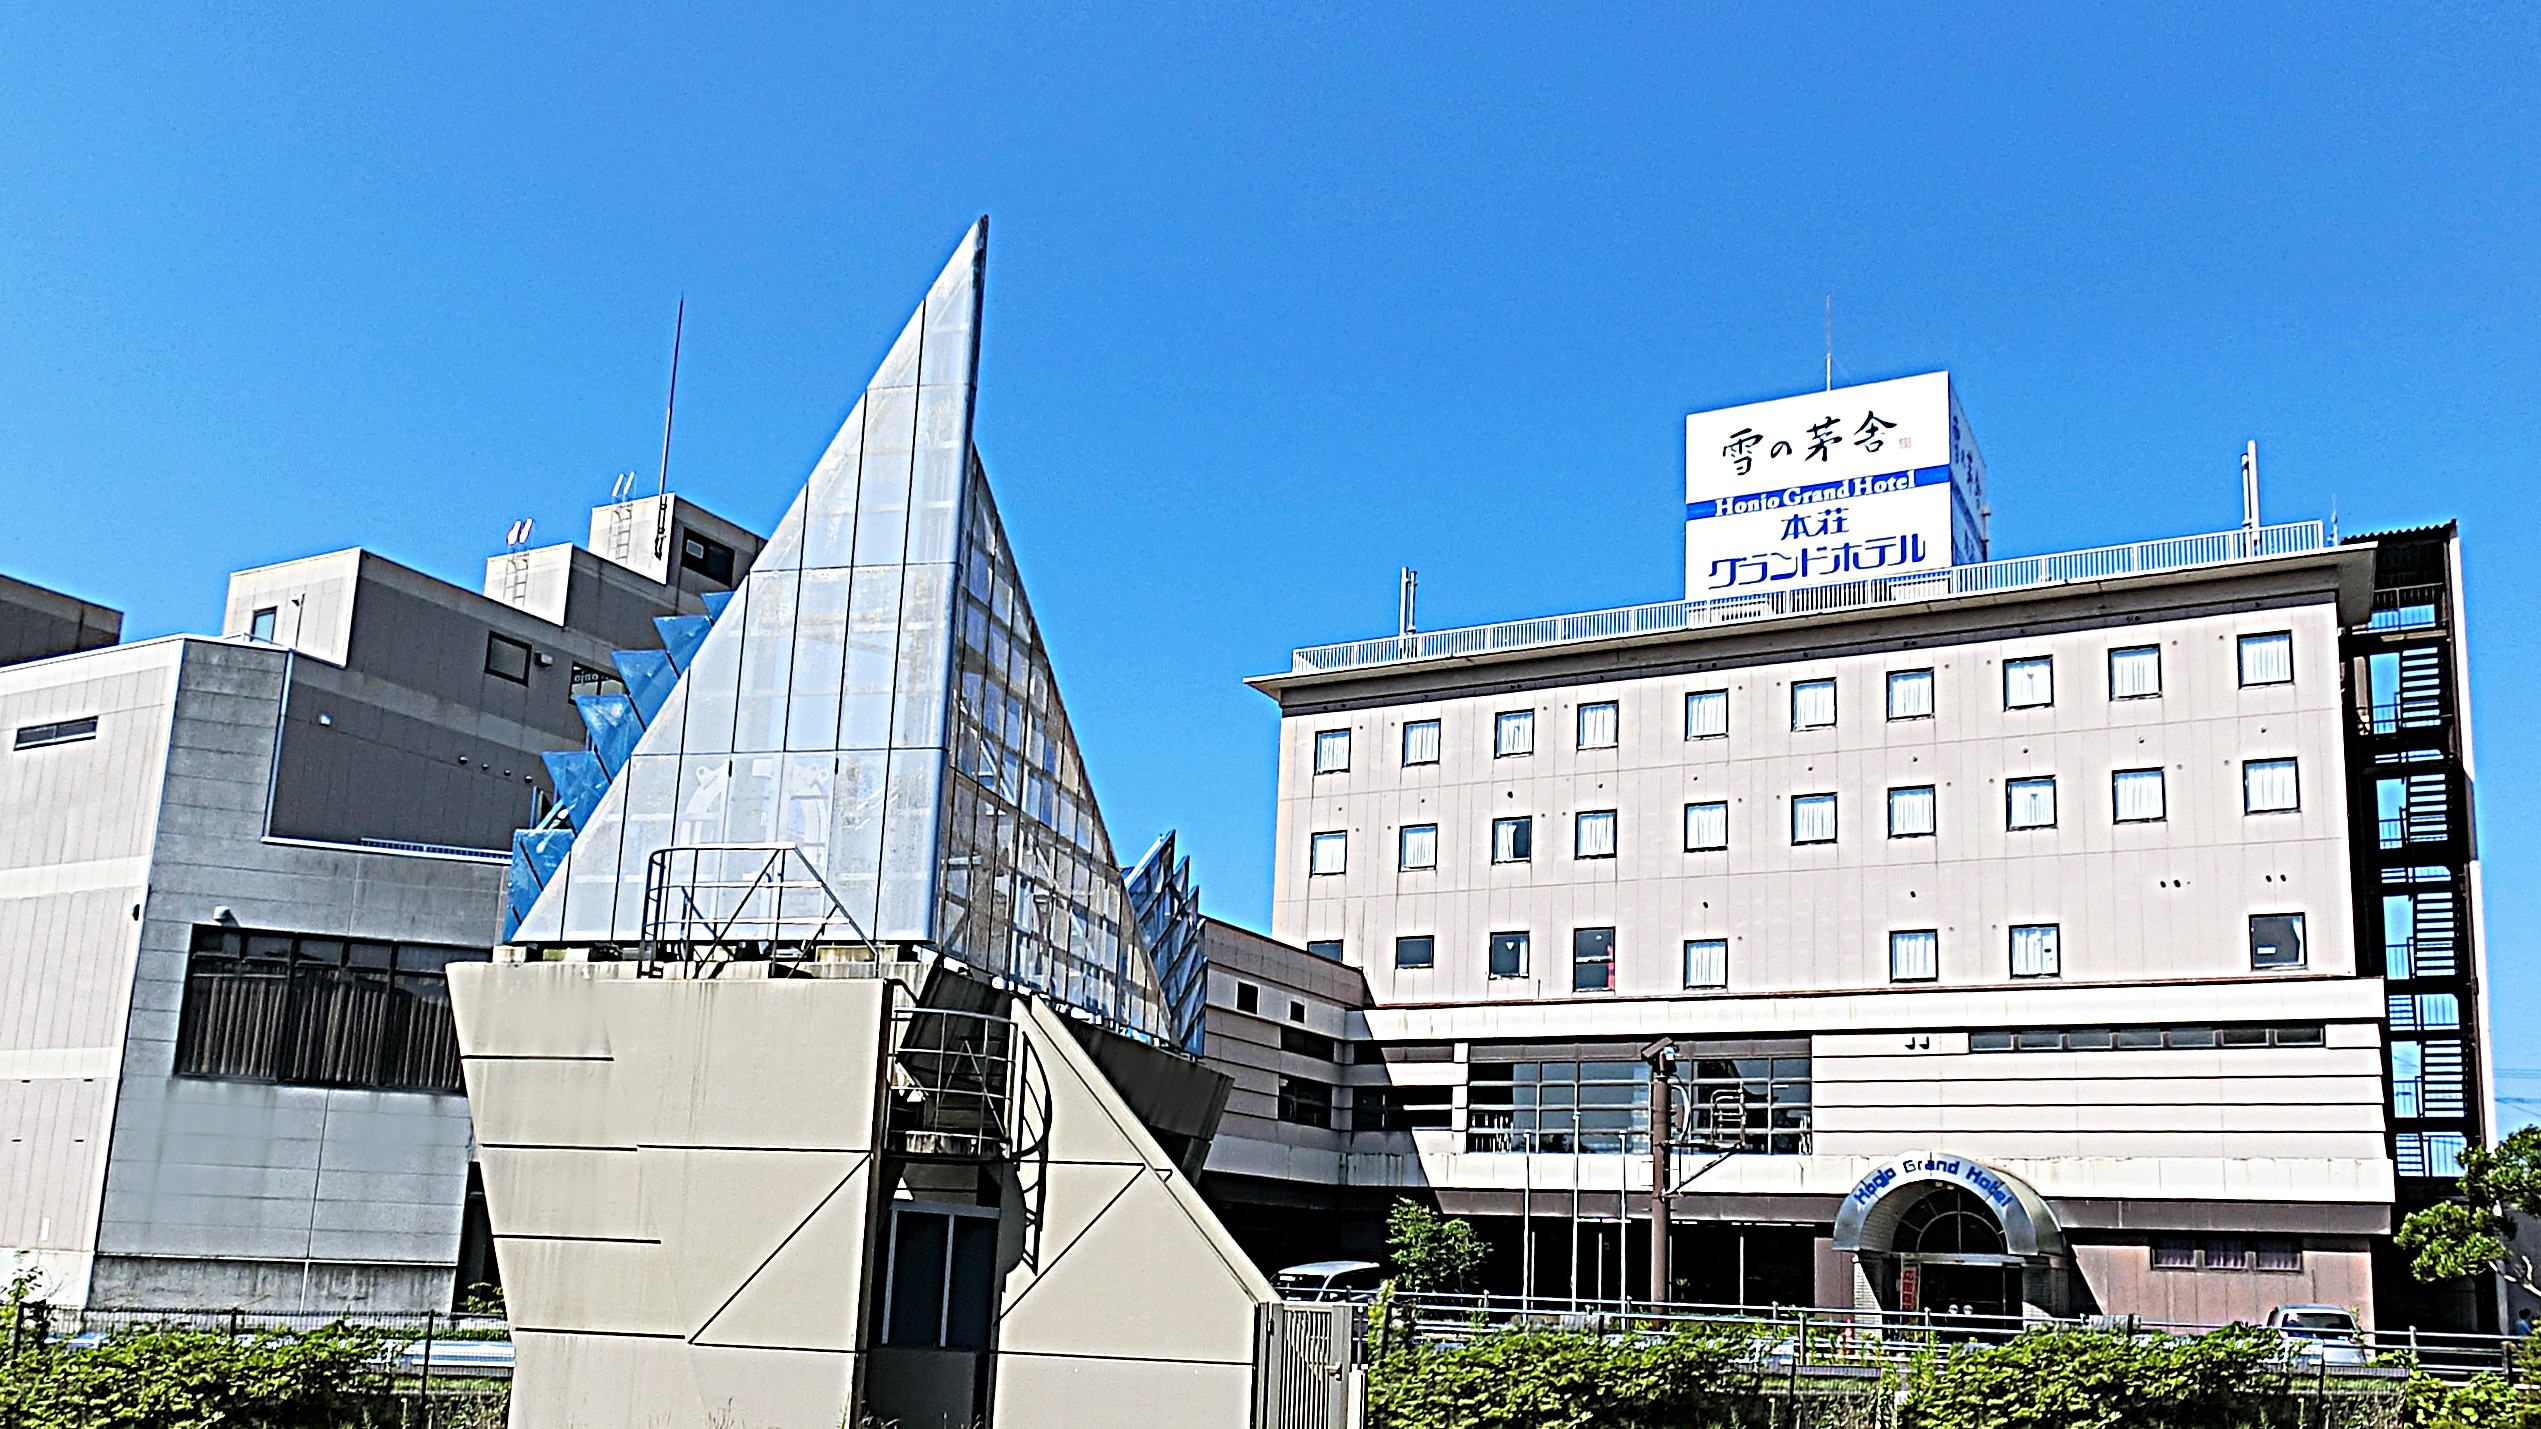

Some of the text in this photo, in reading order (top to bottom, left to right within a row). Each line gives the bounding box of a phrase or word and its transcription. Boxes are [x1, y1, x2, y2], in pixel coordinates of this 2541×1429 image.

[1714, 469, 1916, 518] Honjo Grand Hotel
[1780, 507, 1850, 541] 本荘
[1708, 533, 1926, 591] グランドホテル
[1902, 1159, 1961, 1176] Grand
[1965, 1165, 2014, 1208] Hotel
